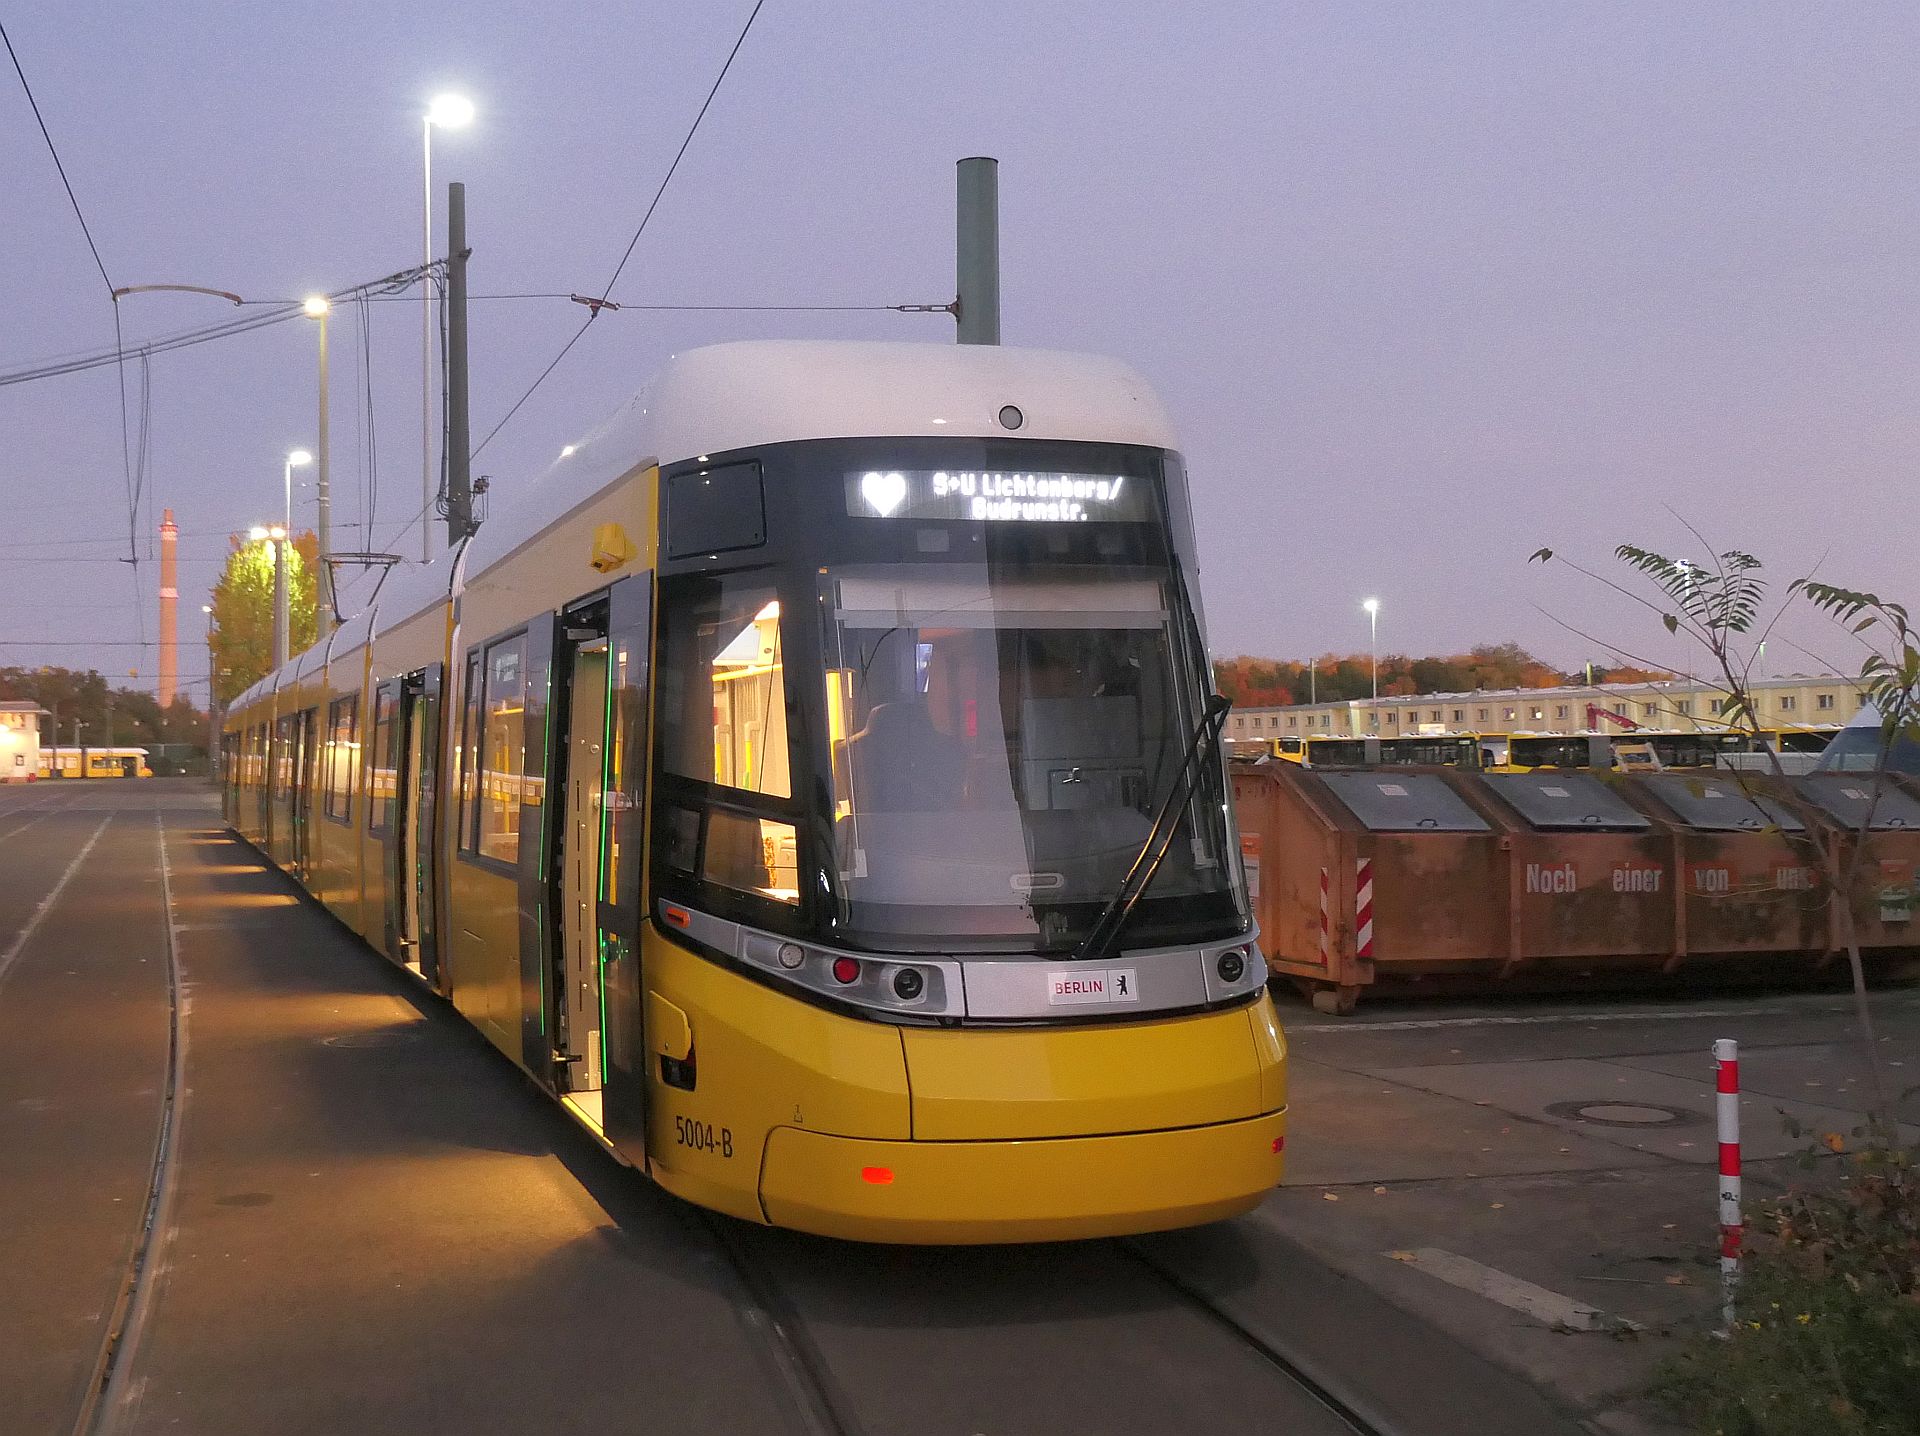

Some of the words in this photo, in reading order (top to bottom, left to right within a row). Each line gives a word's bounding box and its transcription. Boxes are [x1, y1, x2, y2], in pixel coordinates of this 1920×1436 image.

[933, 472, 976, 496] S+U
[1526, 863, 1577, 893] Noch
[1613, 862, 1663, 892] einer
[1695, 867, 1729, 892] von
[1055, 980, 1103, 994] BERLIN
[676, 1115, 733, 1158] 5004-B
